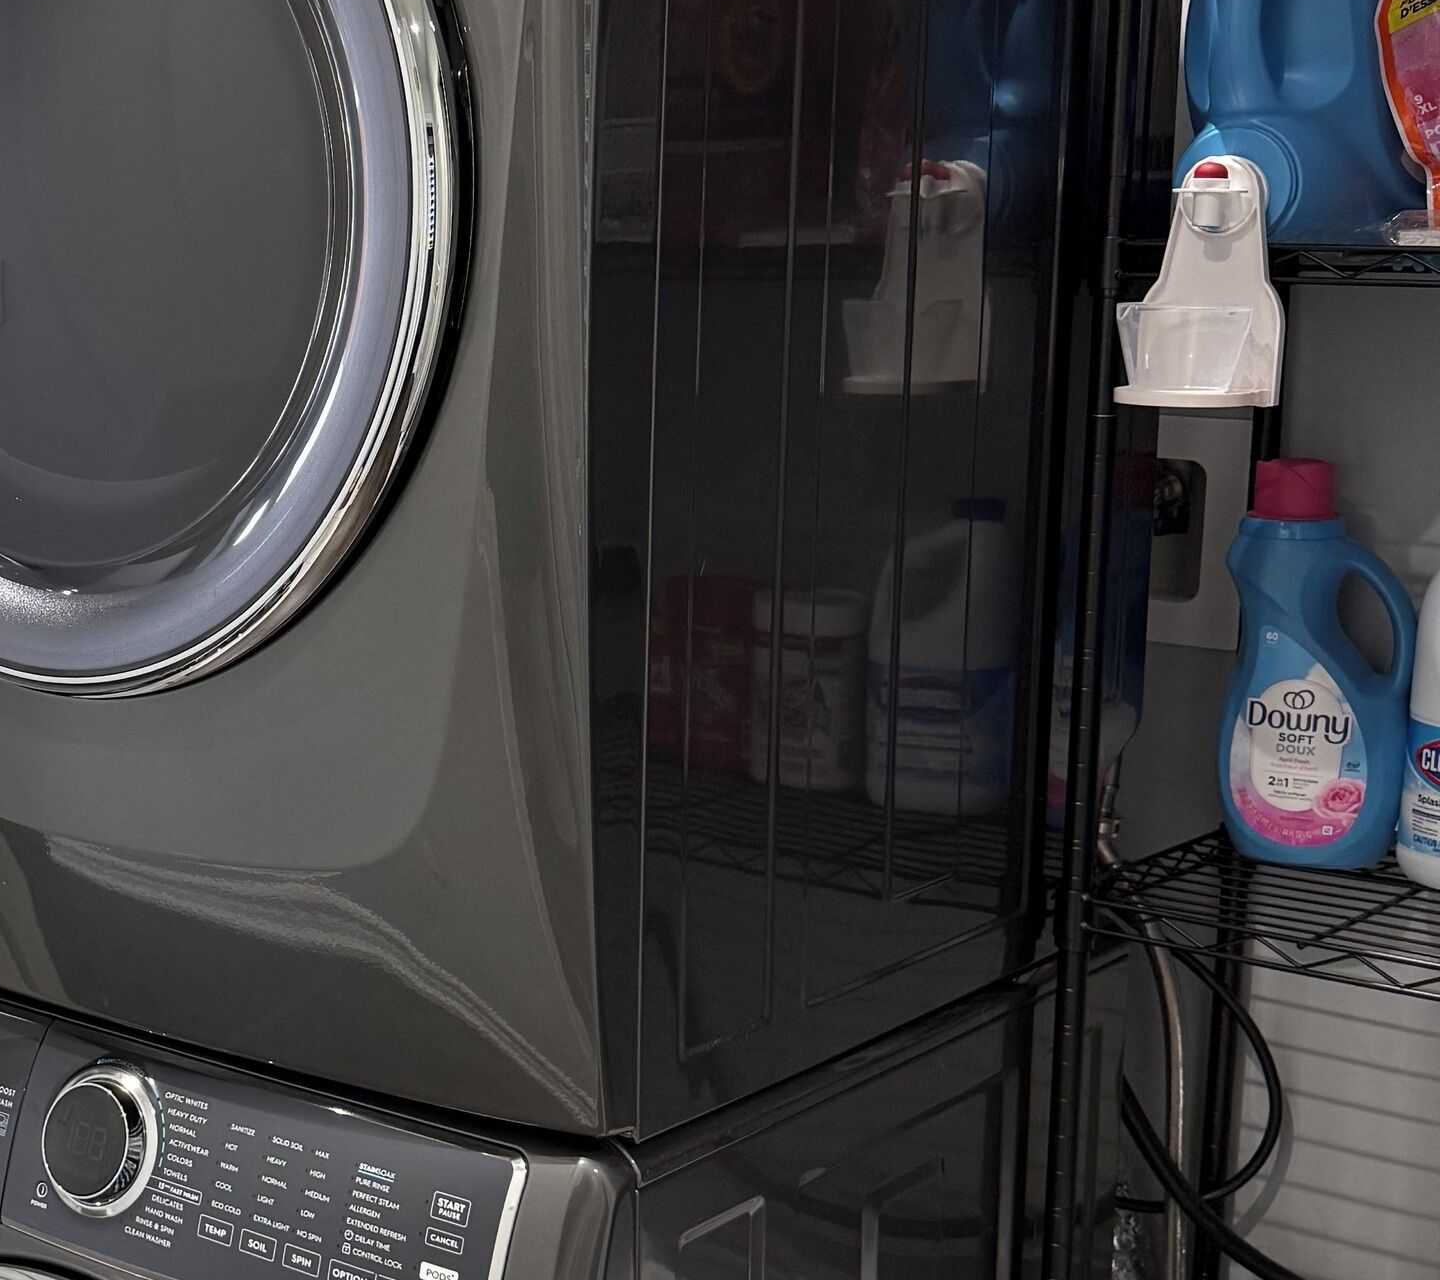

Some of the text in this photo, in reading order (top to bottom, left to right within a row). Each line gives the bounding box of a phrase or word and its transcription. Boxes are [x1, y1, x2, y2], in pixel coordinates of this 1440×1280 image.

[1414, 95, 1423, 105] 9
[1419, 102, 1437, 115] XL
[1247, 699, 1350, 745] Downy
[1278, 732, 1315, 745] SOFT
[1276, 743, 1316, 756] DOUX
[165, 1091, 209, 1110] OPTIC WHITES
[167, 1107, 208, 1125] HEAVY DUTY
[169, 1123, 197, 1138] NORMAL
[231, 1123, 256, 1137] SANITIZE
[168, 1138, 210, 1157] ACTIVEWEAR
[225, 1142, 239, 1152] HOT
[315, 1149, 330, 1160] MAX
[167, 1153, 193, 1168] COLORS
[220, 1161, 239, 1173] WARM
[266, 1155, 287, 1167] HEAVY
[163, 1167, 188, 1182] TOWELS
[309, 1169, 326, 1180] HIGH
[215, 1180, 233, 1192] COOL
[261, 1175, 288, 1190] NORMAL
[355, 1177, 391, 1193] PURE RINSE
[30, 1198, 48, 1209] POWER
[151, 1193, 184, 1211] DELICATES
[257, 1194, 275, 1206] LIGHT
[304, 1189, 330, 1203] MEDIUM
[352, 1189, 401, 1210] PERFECT STEAM
[211, 1200, 242, 1216] ECO COLD
[348, 1203, 381, 1219] ALLERGEN
[437, 1197, 467, 1213] START
[145, 1205, 183, 1225] HAND WASH
[300, 1208, 315, 1219] LOW
[438, 1208, 462, 1221] PAUSE
[135, 1215, 153, 1228] RINSE
[160, 1225, 175, 1236] SPIN
[204, 1223, 227, 1238] TEMP
[253, 1214, 290, 1232] EXTRA LIGHT
[346, 1217, 407, 1242] EXTENDED REFRESH
[124, 1226, 172, 1248] CLEAN WASHER
[296, 1229, 322, 1243] NO SPIN
[354, 1235, 391, 1252] DELAY TIME
[430, 1233, 459, 1249] CANCEL
[247, 1238, 267, 1253] SOIL
[291, 1253, 312, 1268] SPIN
[352, 1249, 403, 1270] CONTROL LOCK
